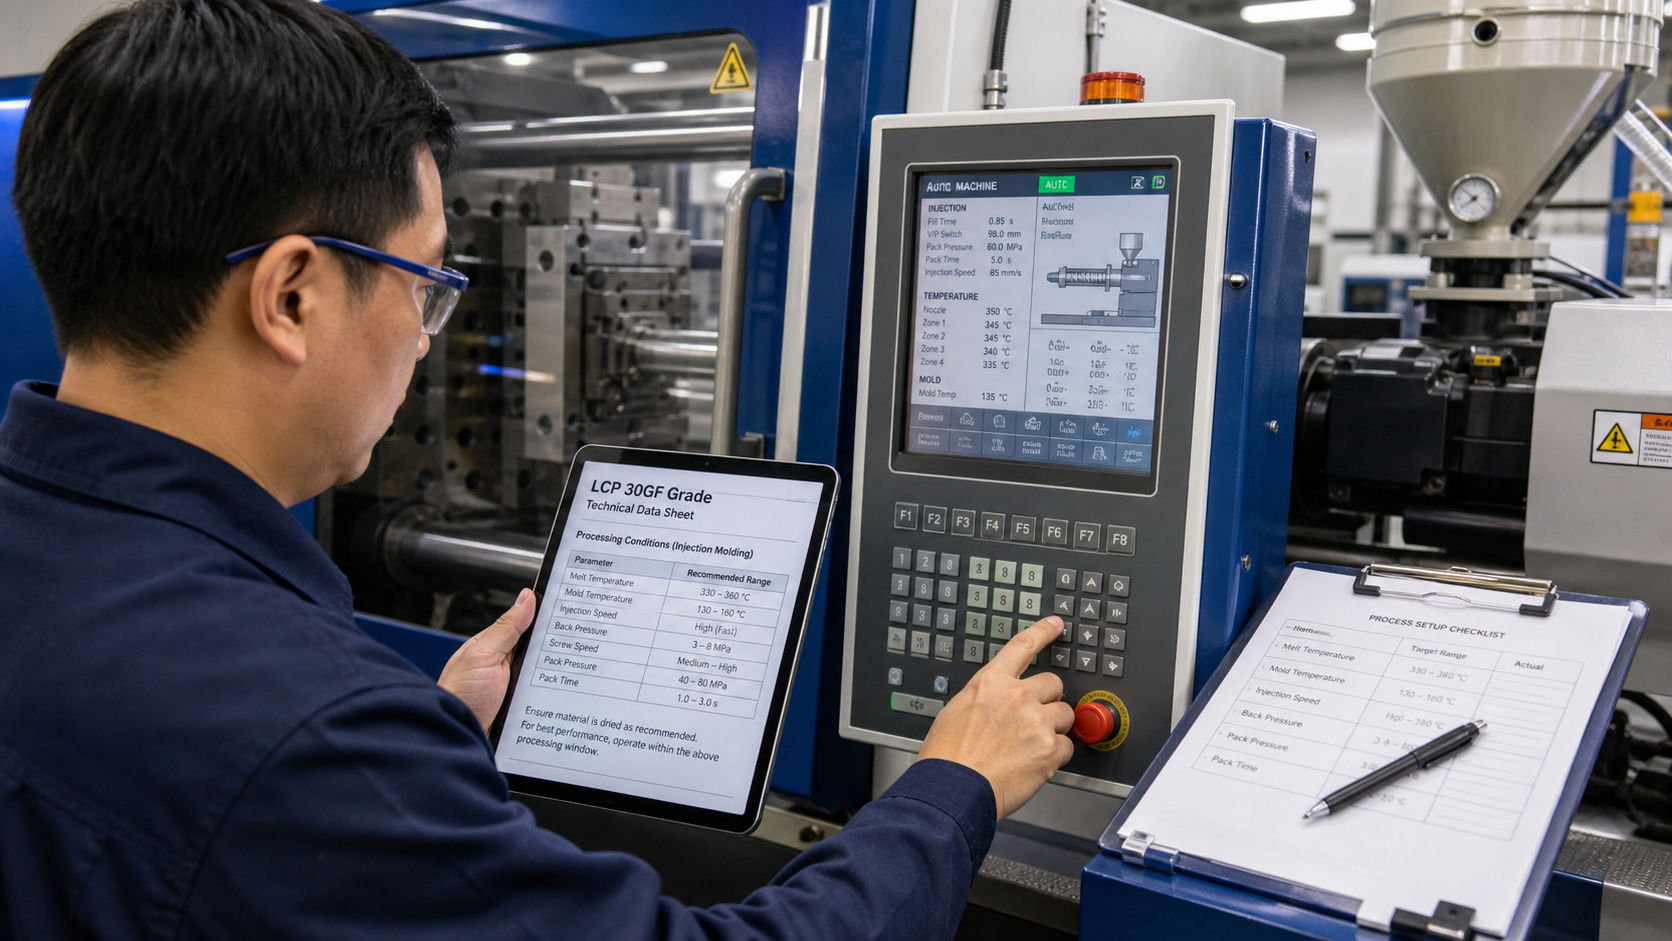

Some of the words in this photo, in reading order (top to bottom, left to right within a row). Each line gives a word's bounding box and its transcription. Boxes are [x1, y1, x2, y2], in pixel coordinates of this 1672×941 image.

[955, 181, 997, 191] MACHINE
[928, 204, 967, 212] INJECTION
[988, 216, 1005, 225] 0.85
[987, 229, 1004, 238] 98.0
[926, 242, 942, 251] Pack
[943, 242, 973, 251] Pressure
[1006, 243, 1022, 251] MPa
[925, 255, 941, 264] Pack
[990, 255, 1003, 264] 5.0
[924, 268, 953, 278] Injection
[954, 268, 976, 278] Speed
[989, 268, 999, 277] 85
[1001, 268, 1022, 277] mm/s
[923, 291, 979, 301] TEMPERATURE
[985, 307, 1000, 316] 350
[1003, 307, 1013, 316] °C
[922, 318, 941, 327] Zone
[942, 319, 946, 327] 1
[984, 320, 999, 329] 345
[1003, 321, 1012, 330] °C
[921, 331, 940, 340] Zone
[940, 332, 946, 340] 2
[983, 334, 999, 342] 345
[1002, 334, 1011, 343] °C
[920, 344, 939, 353] Zone
[939, 345, 945, 354] 3
[983, 347, 998, 356] 340
[1001, 348, 1011, 356] °C
[920, 358, 938, 366] Zone
[939, 358, 944, 366] 4
[982, 360, 997, 369] 335
[1001, 361, 1010, 370] °C
[919, 375, 942, 384] MOLD
[918, 389, 936, 398] Mold
[937, 390, 957, 400] Temp
[981, 392, 996, 401] 135
[999, 393, 1008, 402] °C
[590, 479, 622, 494] LCP
[624, 482, 665, 499] 30GF
[667, 486, 713, 504] Grade
[586, 499, 635, 514] Technical
[636, 504, 661, 517] Data
[663, 507, 695, 520] Sheet
[900, 510, 911, 521] F1
[927, 513, 941, 525] F2
[956, 516, 970, 528] F3
[986, 519, 999, 531] F4
[1016, 522, 1030, 535] F5
[1047, 526, 1061, 538] F6
[1079, 530, 1094, 542] F7
[1112, 533, 1128, 546] F8
[575, 530, 623, 545] Processing
[624, 536, 670, 549] Conditions
[671, 541, 713, 555] (Injection
[714, 546, 754, 560] Molding)
[574, 555, 614, 568] Parameter
[899, 553, 904, 565] 1
[922, 556, 929, 567] 2
[588, 573, 635, 588] Temperature
[687, 569, 745, 583] Recommended
[746, 575, 772, 587] Range
[564, 588, 585, 598] Mold
[586, 590, 634, 604] Temperature
[699, 588, 716, 597] 330
[724, 590, 739, 600] 360
[741, 592, 751, 602] °C
[559, 604, 592, 616] Injection
[593, 608, 618, 620] Speed
[697, 605, 712, 615] 130
[720, 608, 734, 618] 160
[737, 609, 746, 619] °C
[574, 624, 608, 637] Pressure
[694, 622, 714, 634] High
[1368, 614, 1413, 627] PROCESS
[1415, 620, 1447, 631] SETUP
[1449, 625, 1506, 639] CHECKLIST
[549, 638, 573, 649] Screw
[574, 642, 600, 653] Speed
[692, 640, 698, 649] 3
[706, 642, 712, 651] 8
[713, 643, 731, 654] MPa
[1282, 643, 1301, 652] Melt
[1303, 646, 1356, 662] Temperature
[1439, 649, 1467, 660] Range
[543, 655, 562, 666] Pack
[563, 658, 598, 671] Pressure
[676, 656, 710, 669] Medium
[718, 662, 738, 674] High
[1514, 660, 1544, 671] Actual
[539, 673, 558, 683] Pack
[560, 675, 579, 687] Time
[1269, 665, 1291, 675] Mold
[1293, 668, 1346, 684] Temperature
[678, 675, 689, 685] 40
[697, 678, 709, 688] 80
[709, 679, 728, 690] MPa
[677, 694, 690, 703] 1.0
[698, 696, 712, 707] 3.0
[713, 700, 718, 708] s
[1255, 686, 1292, 699] Injection
[1293, 693, 1321, 706] Speed
[525, 705, 554, 719] Ensure
[554, 711, 590, 725] material
[591, 716, 598, 726] is
[599, 717, 622, 730] dried
[623, 723, 633, 731] as
[634, 725, 698, 743] recommended.
[1241, 709, 1262, 720] Back
[1264, 714, 1303, 728] Pressure
[516, 733, 563, 751] processing
[564, 742, 600, 757] window.
[520, 719, 535, 730] For
[536, 722, 554, 734] best
[555, 725, 611, 746] performance,
[612, 736, 646, 750] operate
[648, 741, 675, 755] within
[676, 746, 691, 757] the
[692, 749, 720, 763] above
[1226, 732, 1248, 743] Pack
[1250, 737, 1289, 752] Pressure
[1211, 755, 1233, 766] Pack
[1236, 760, 1258, 773] Time
